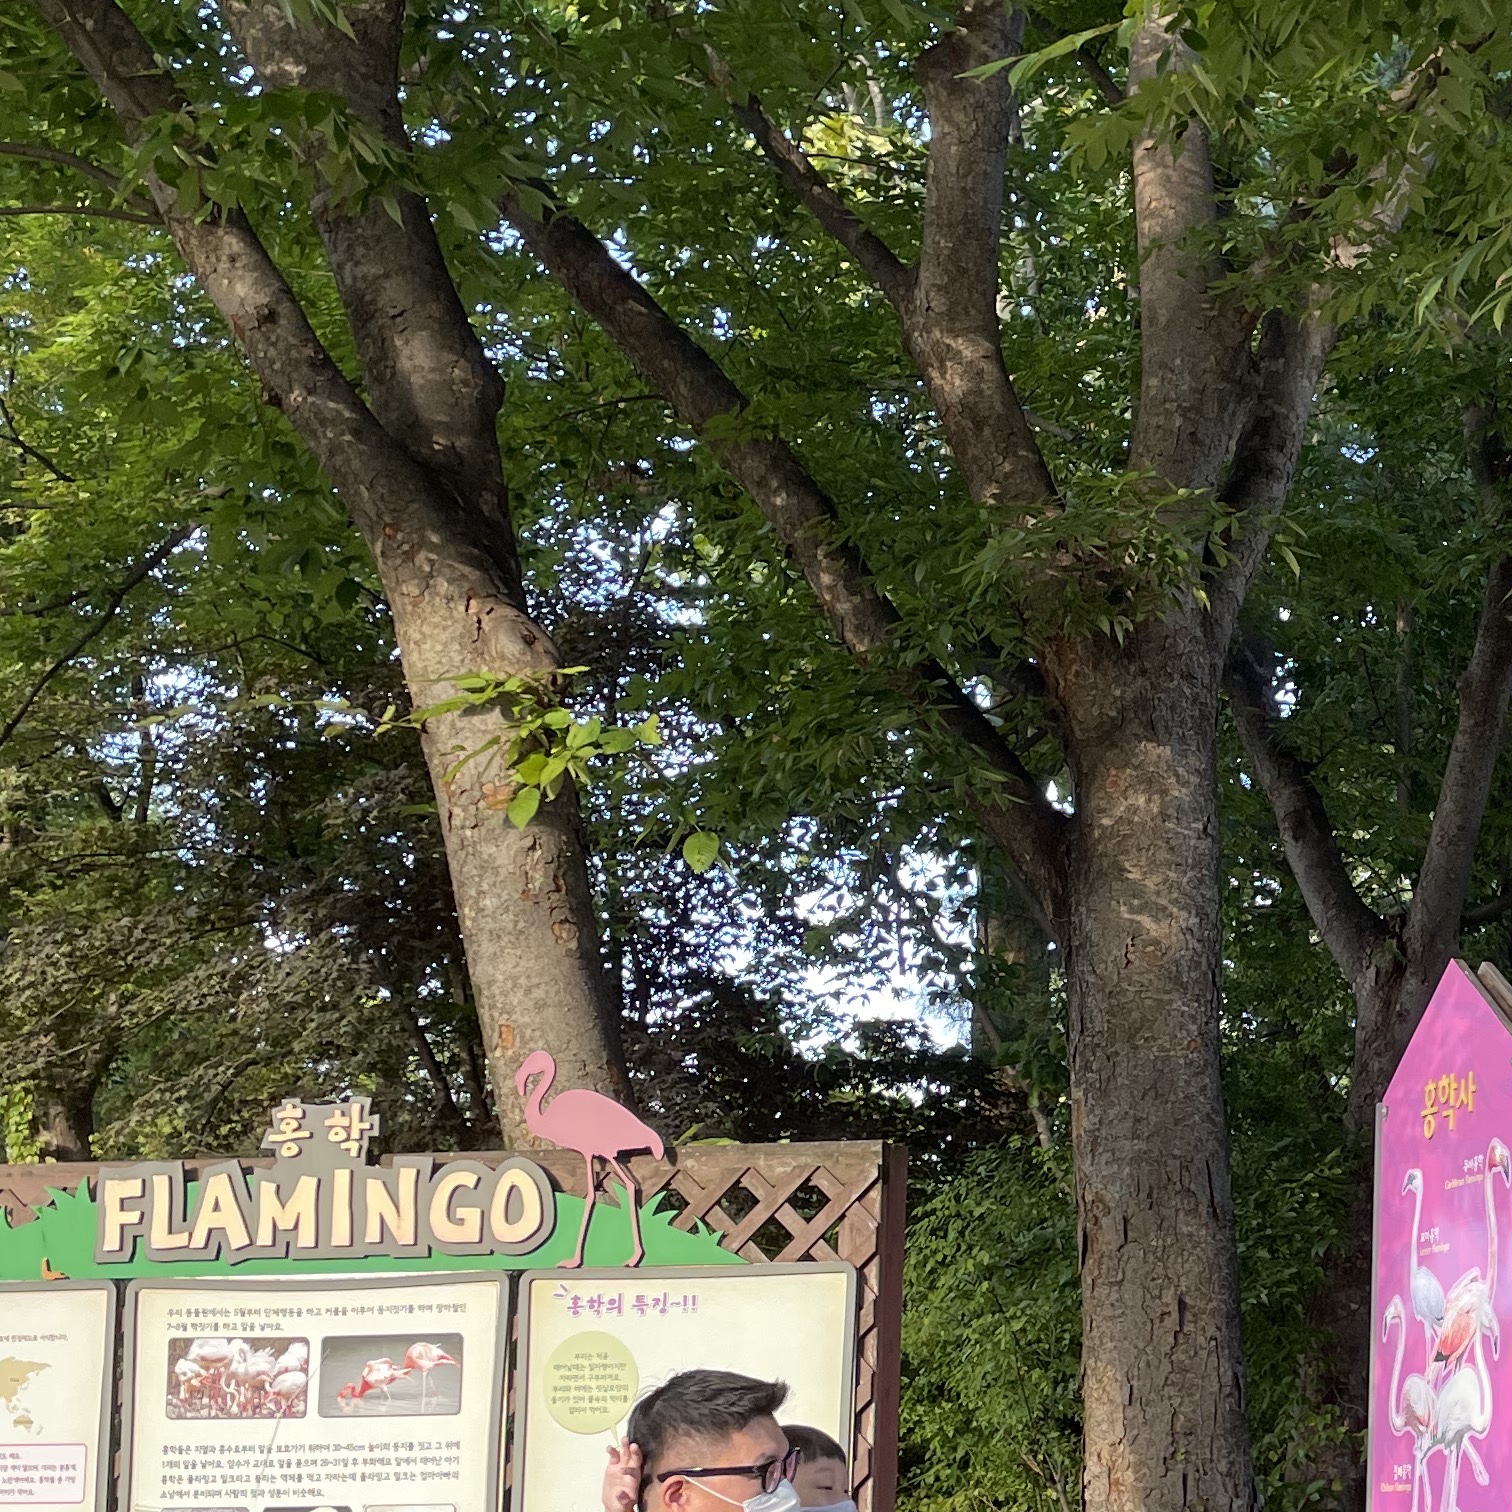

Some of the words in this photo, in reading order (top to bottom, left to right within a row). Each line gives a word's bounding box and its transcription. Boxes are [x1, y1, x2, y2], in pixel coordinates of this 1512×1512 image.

[1420, 1070, 1477, 1140] 홍학사
[267, 1102, 374, 1158] 홍학
[102, 1166, 543, 1252] FLAMINGO
[167, 1307, 183, 1317] 우리
[306, 1307, 322, 1316] 하고
[566, 1291, 624, 1317] 홍학의
[630, 1291, 699, 1317] 특징~!!
[222, 1322, 238, 1331] 하고
